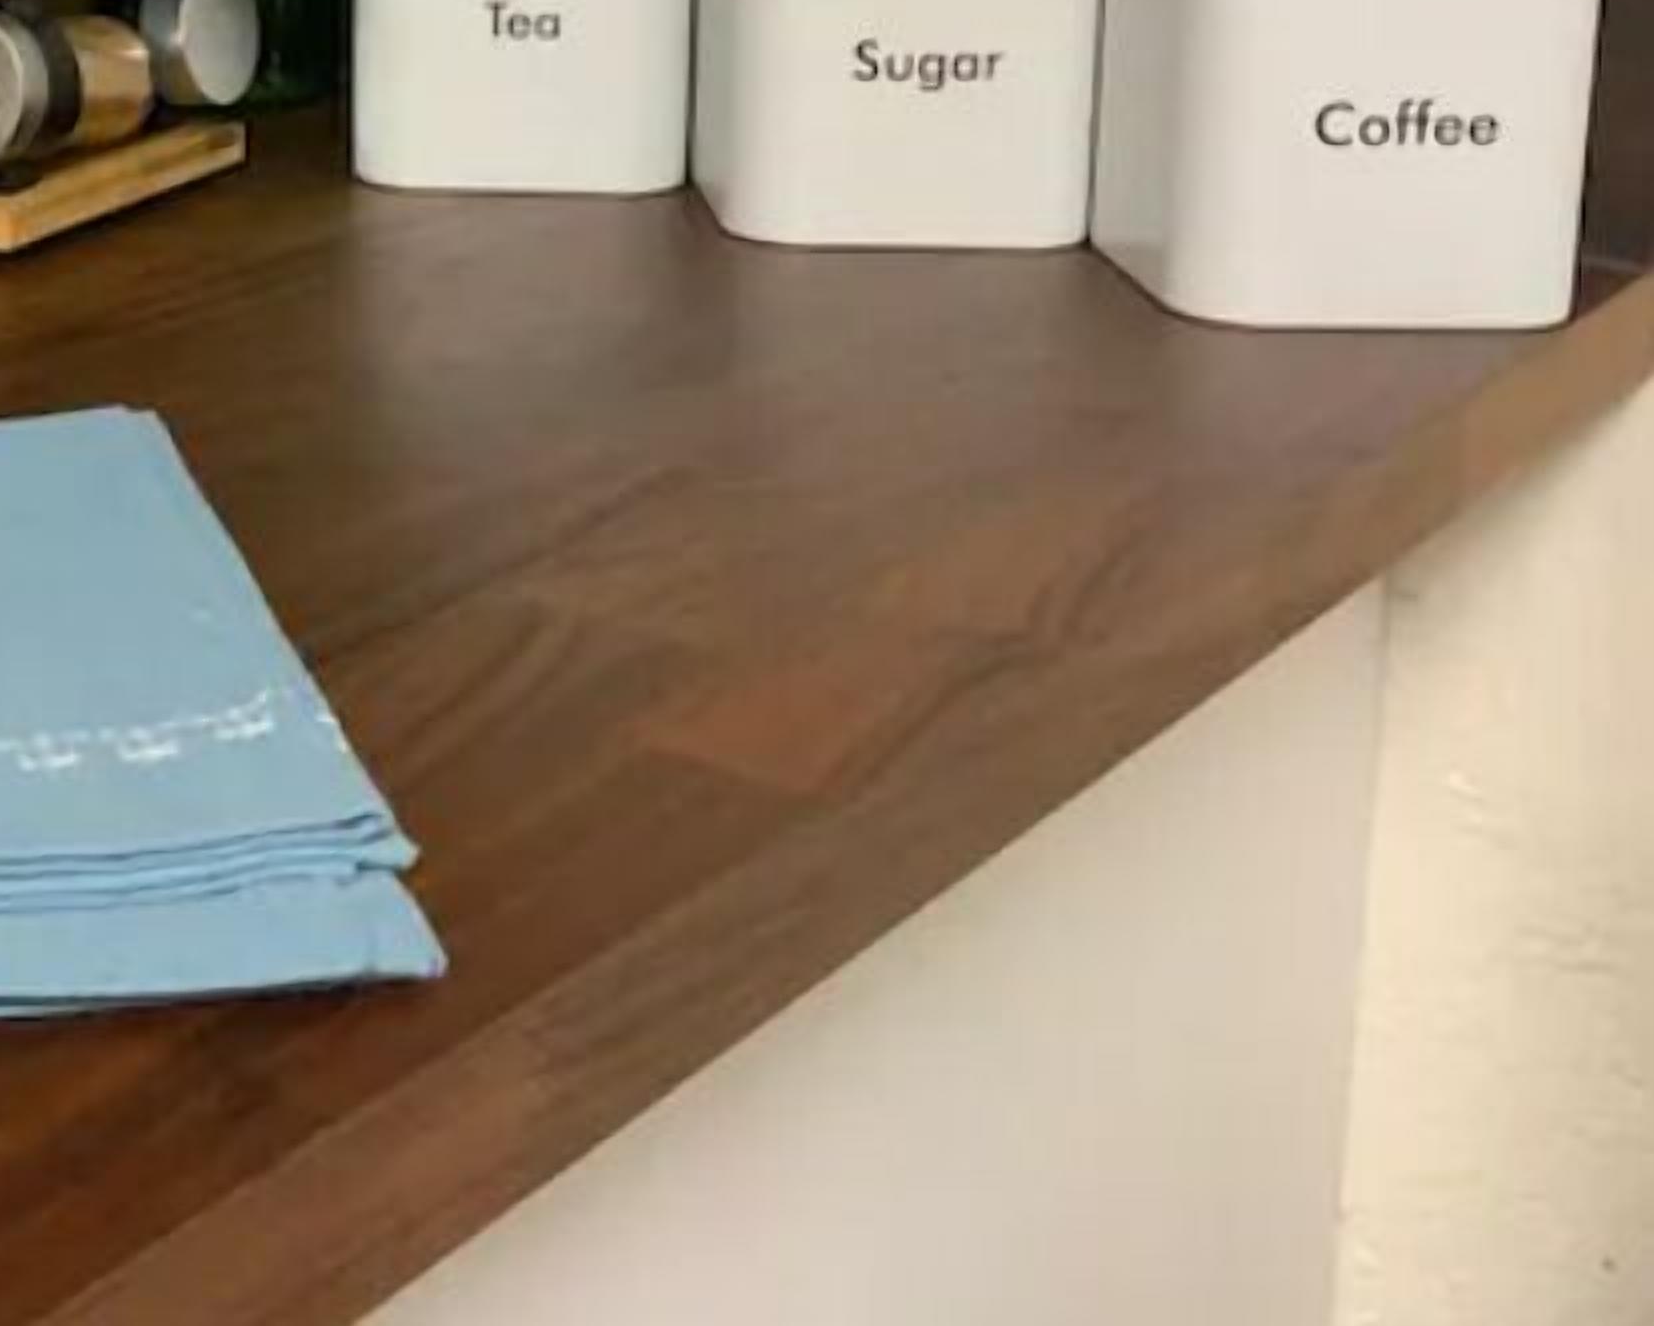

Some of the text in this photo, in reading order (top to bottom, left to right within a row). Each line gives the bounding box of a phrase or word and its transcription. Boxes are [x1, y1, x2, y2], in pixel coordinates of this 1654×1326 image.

[484, 0, 562, 41] Tea
[852, 38, 1003, 94] Sugar
[1313, 97, 1501, 149] Coffee
